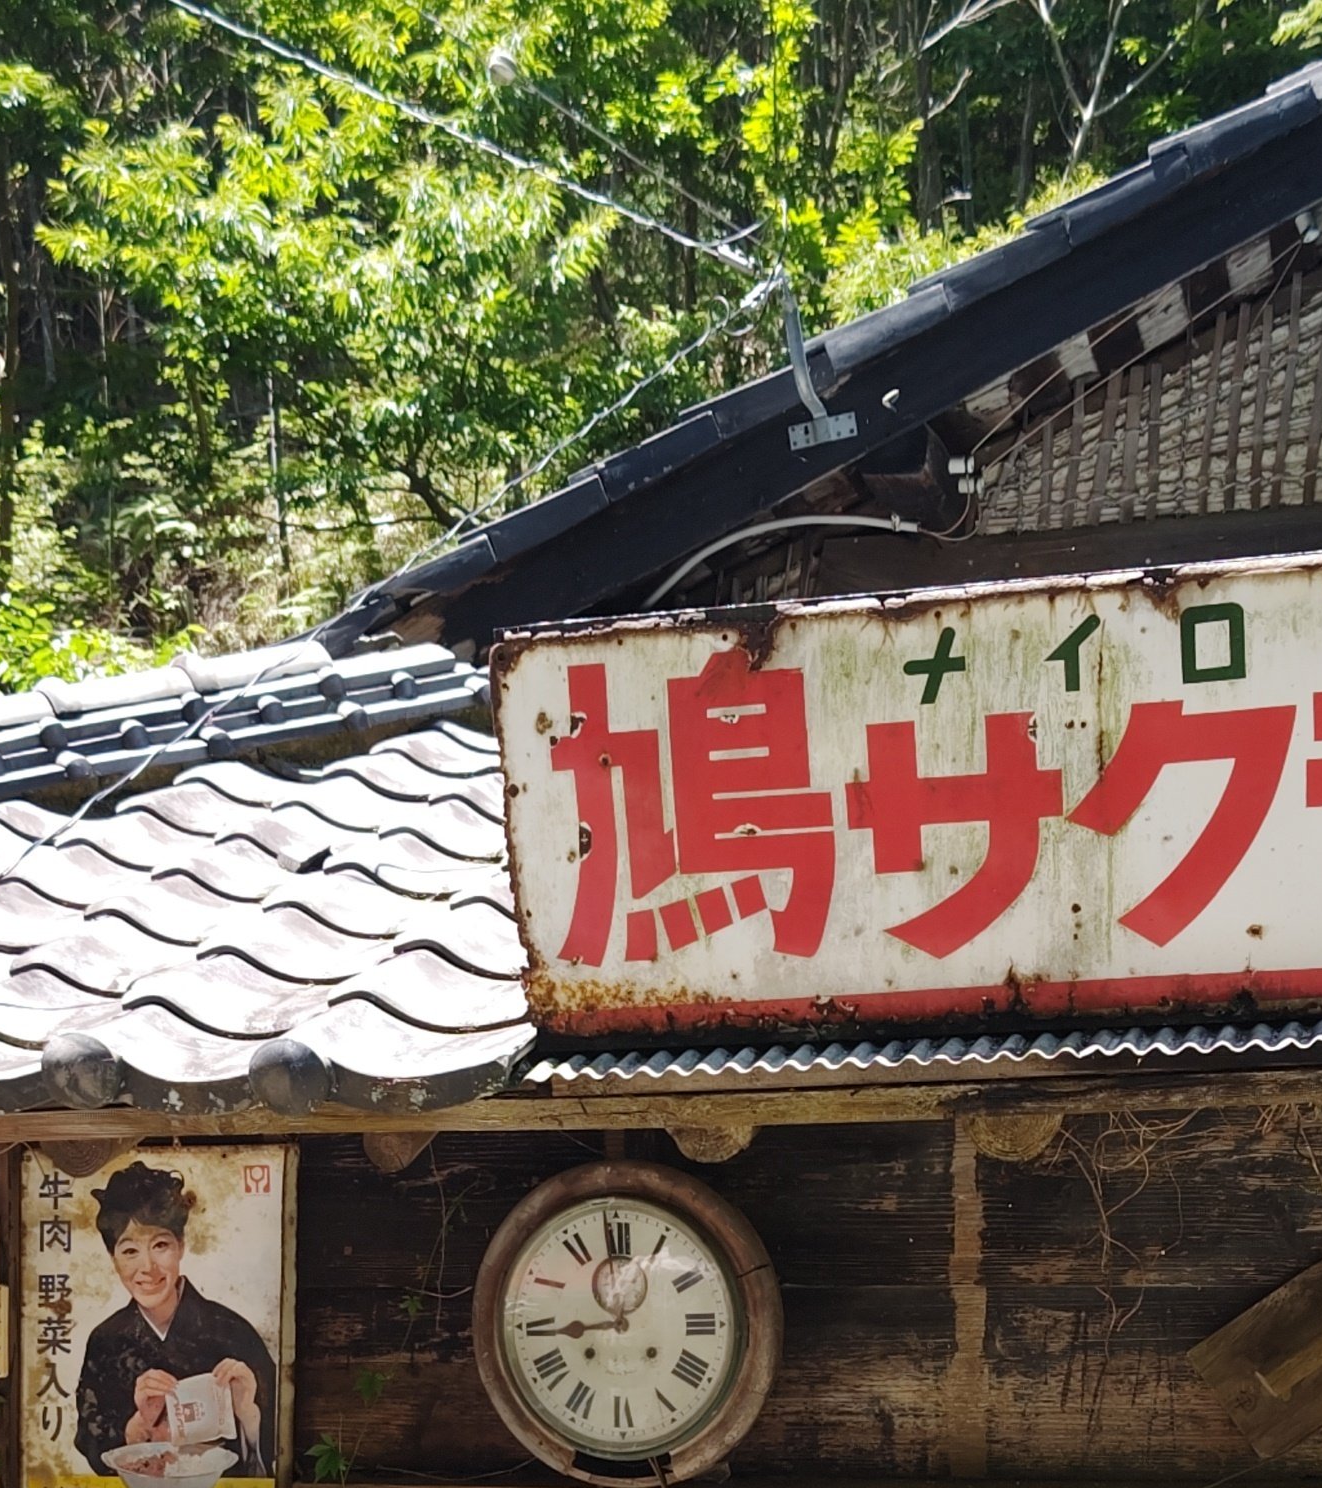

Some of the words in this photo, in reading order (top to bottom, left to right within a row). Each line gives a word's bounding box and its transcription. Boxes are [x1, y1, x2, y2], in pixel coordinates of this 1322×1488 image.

[38, 1170, 74, 1252] 牛肉
[36, 1273, 73, 1442] 野菜入り
